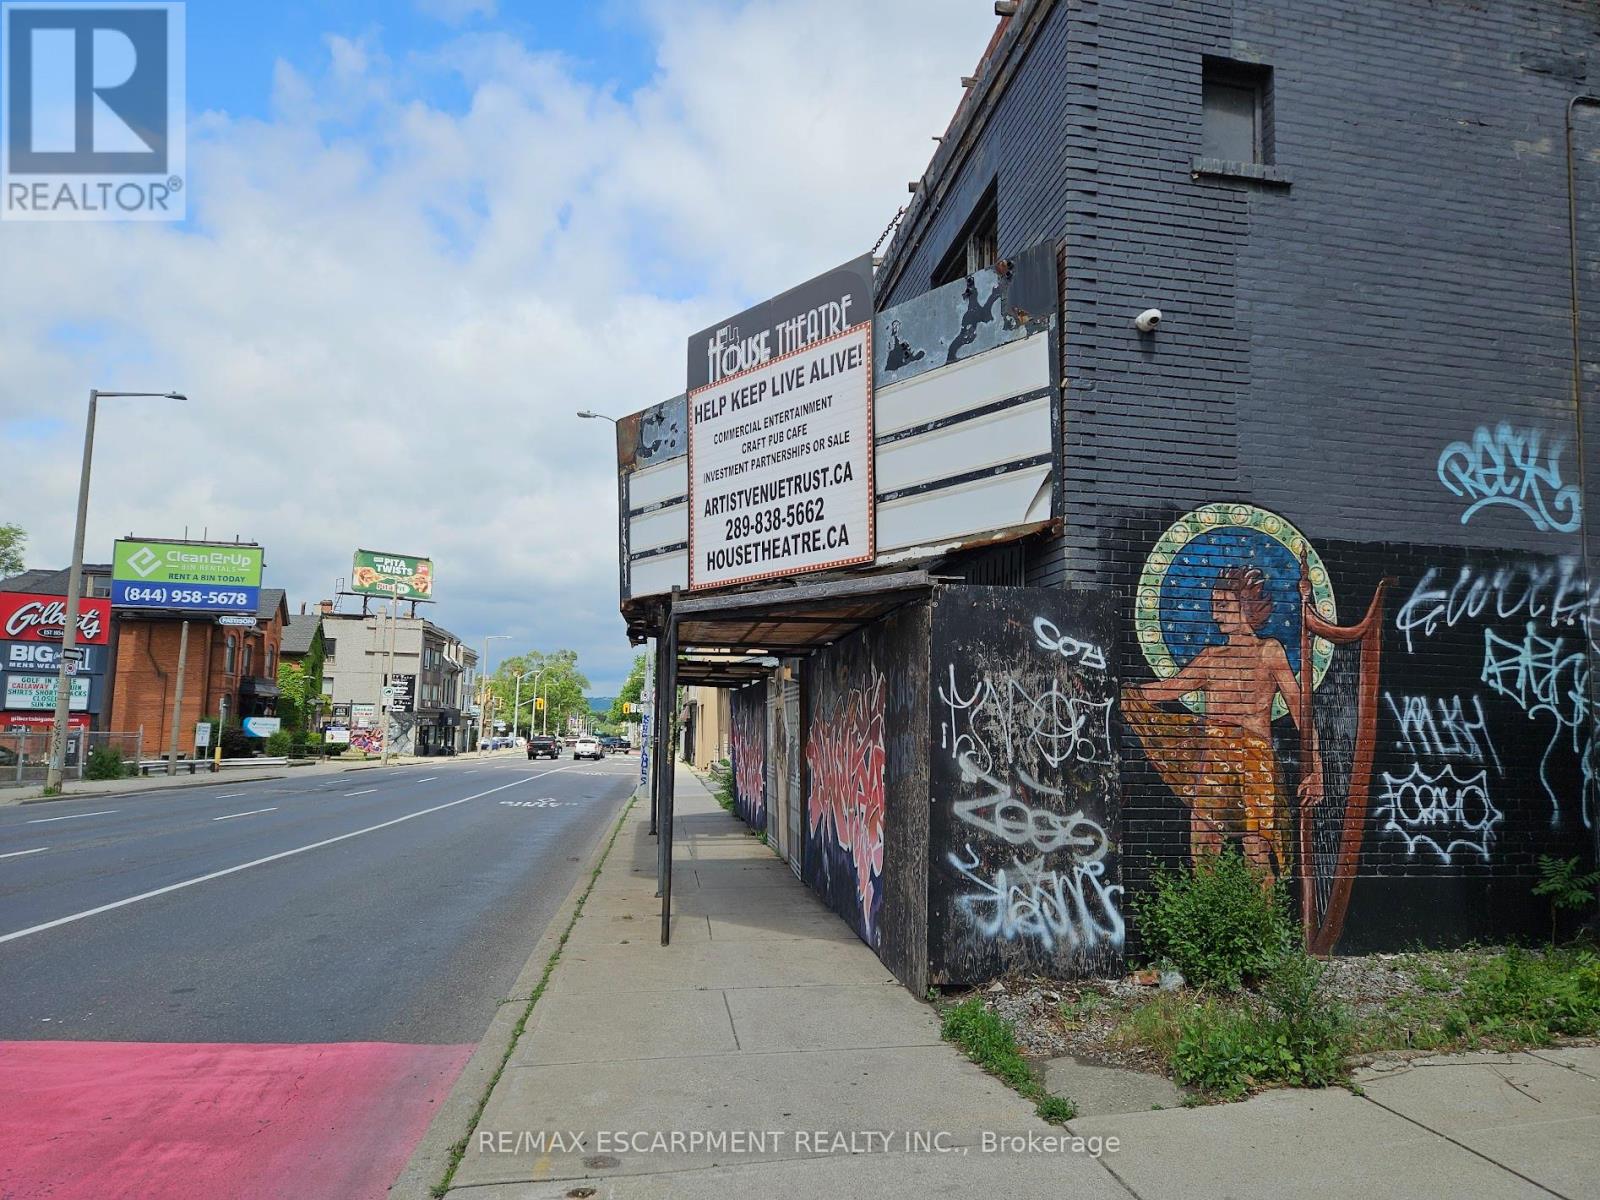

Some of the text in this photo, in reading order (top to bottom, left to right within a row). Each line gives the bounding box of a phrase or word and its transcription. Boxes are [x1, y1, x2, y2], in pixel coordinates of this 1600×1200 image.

[775, 293, 853, 356] THEATRE
[694, 343, 863, 424] HELP KEEP LIVE ALIVE!
[713, 395, 833, 445] COMMERCIAL ENTERTAINMENT
[741, 423, 808, 454] CRAFT PUB CAFE
[703, 430, 851, 484] INVESTMENT PARTNERSHIPS OR SALE
[703, 460, 854, 518] ARTISTVENUETRUST.CA
[725, 497, 825, 541] 289-838-5662
[384, 557, 406, 568] PITA
[706, 523, 850, 572] HOUSETHEATRE.CA
[168, 572, 190, 580] RENT
[192, 573, 200, 581] A
[218, 575, 246, 583] TODAY
[375, 564, 414, 576] TWISTS
[124, 587, 248, 606] (844) 958-5678
[9, 645, 54, 662] BIG
